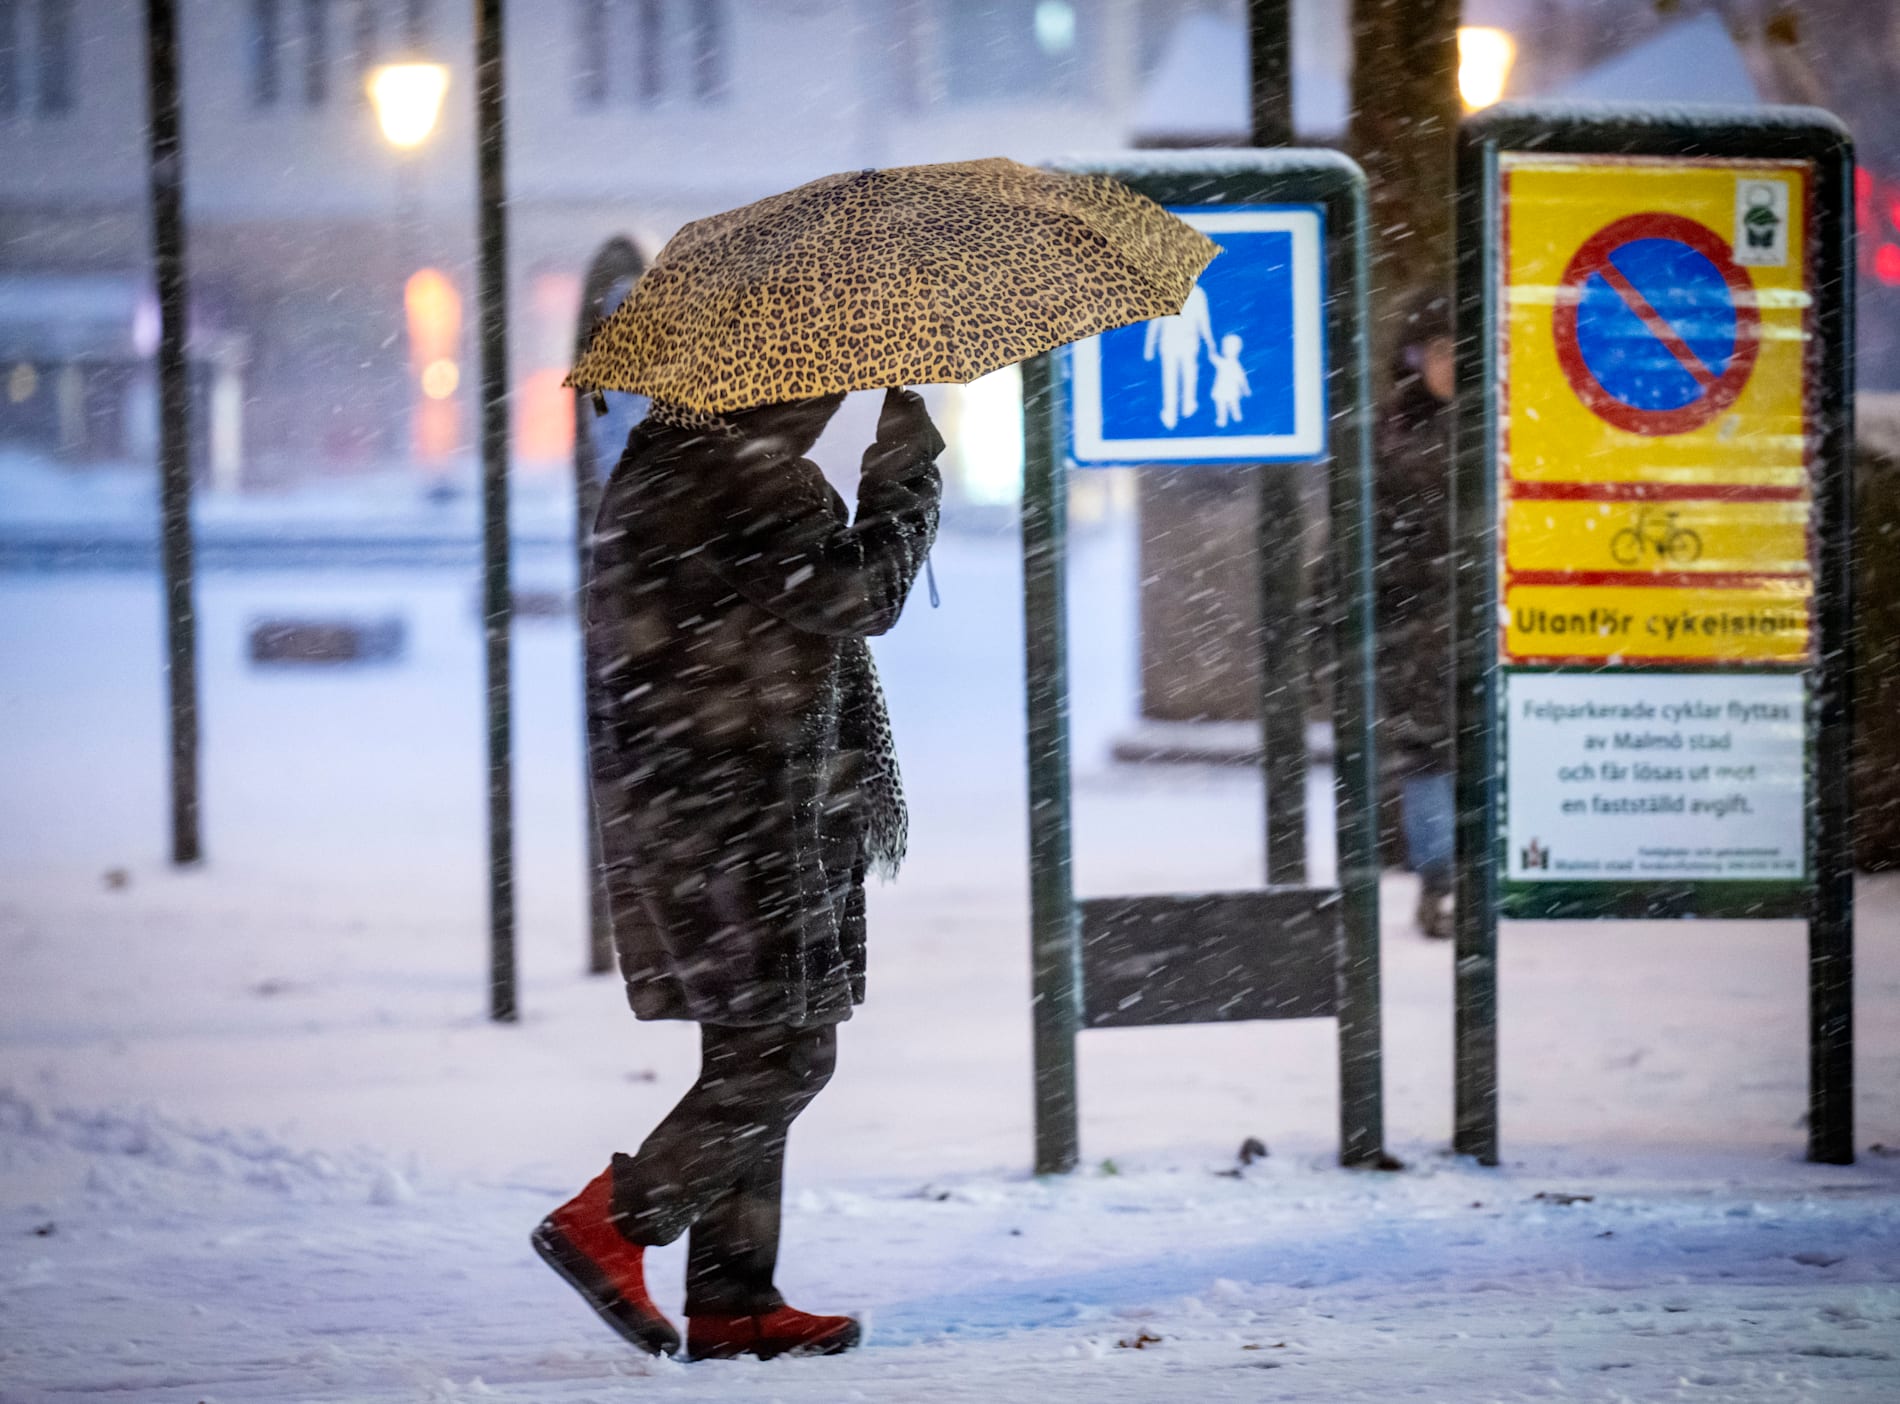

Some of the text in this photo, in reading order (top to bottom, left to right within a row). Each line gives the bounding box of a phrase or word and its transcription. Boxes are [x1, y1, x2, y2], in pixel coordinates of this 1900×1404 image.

[1516, 608, 1633, 636] Utanför
[1523, 700, 1790, 722] Felparkerade cyklar flyttas
[1584, 731, 1730, 749] av Malmö stad
[1558, 762, 1756, 781] och får lösas ut mot
[1562, 794, 1753, 817] en fastställd avgift.
